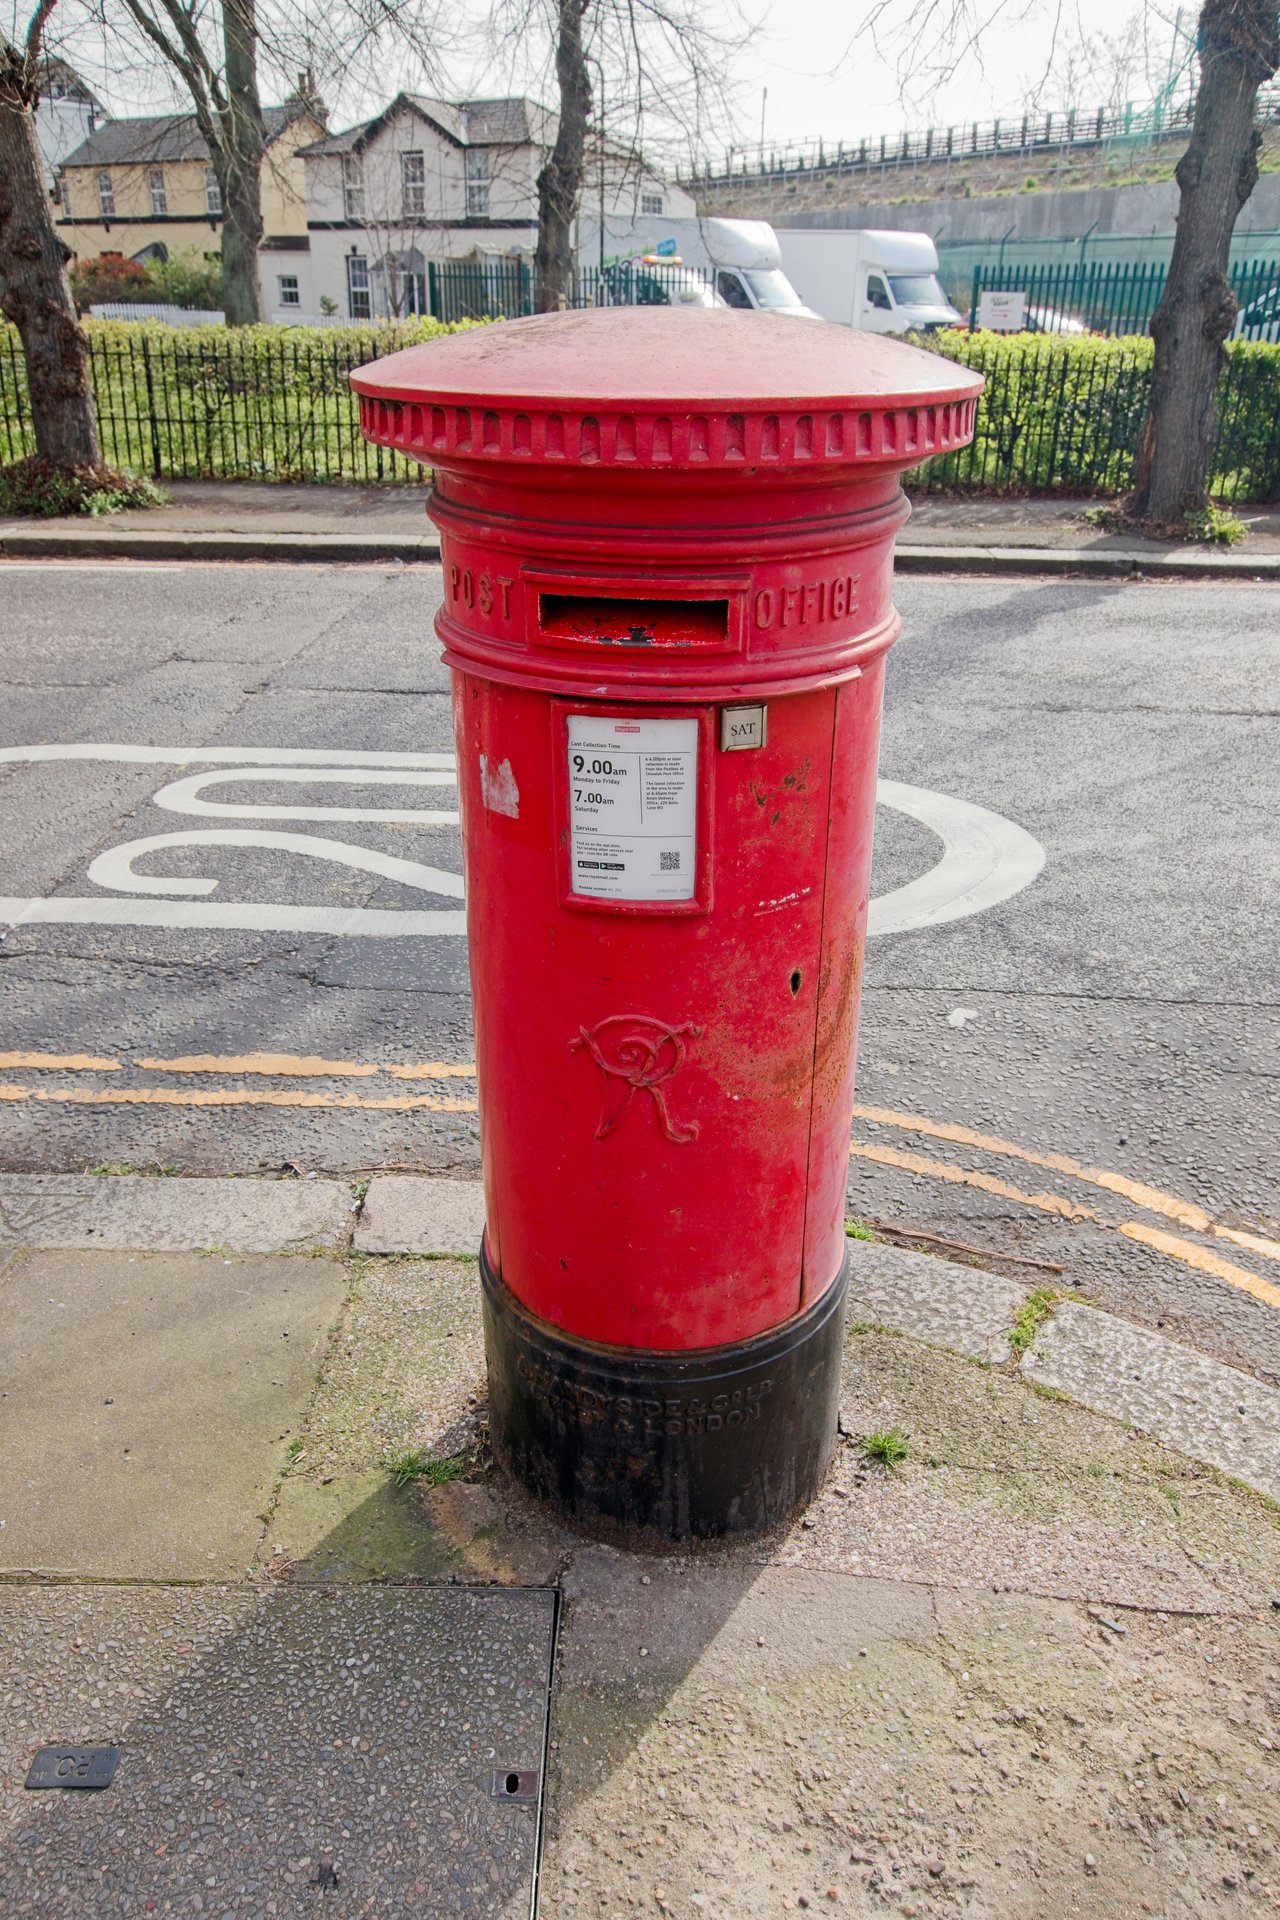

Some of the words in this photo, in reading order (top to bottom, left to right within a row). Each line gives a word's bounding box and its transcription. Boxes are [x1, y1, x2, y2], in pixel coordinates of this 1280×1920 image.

[450, 562, 513, 621] POST
[755, 573, 861, 630] OFFICE
[730, 722, 756, 737] SAT
[573, 755, 627, 776] 9.00am
[573, 776, 594, 784] Monday
[603, 778, 620, 786] Friday
[574, 789, 615, 805] 7.00am
[574, 805, 599, 814] Saturday
[575, 824, 598, 832] Services
[644, 1401, 762, 1437] LONDON
